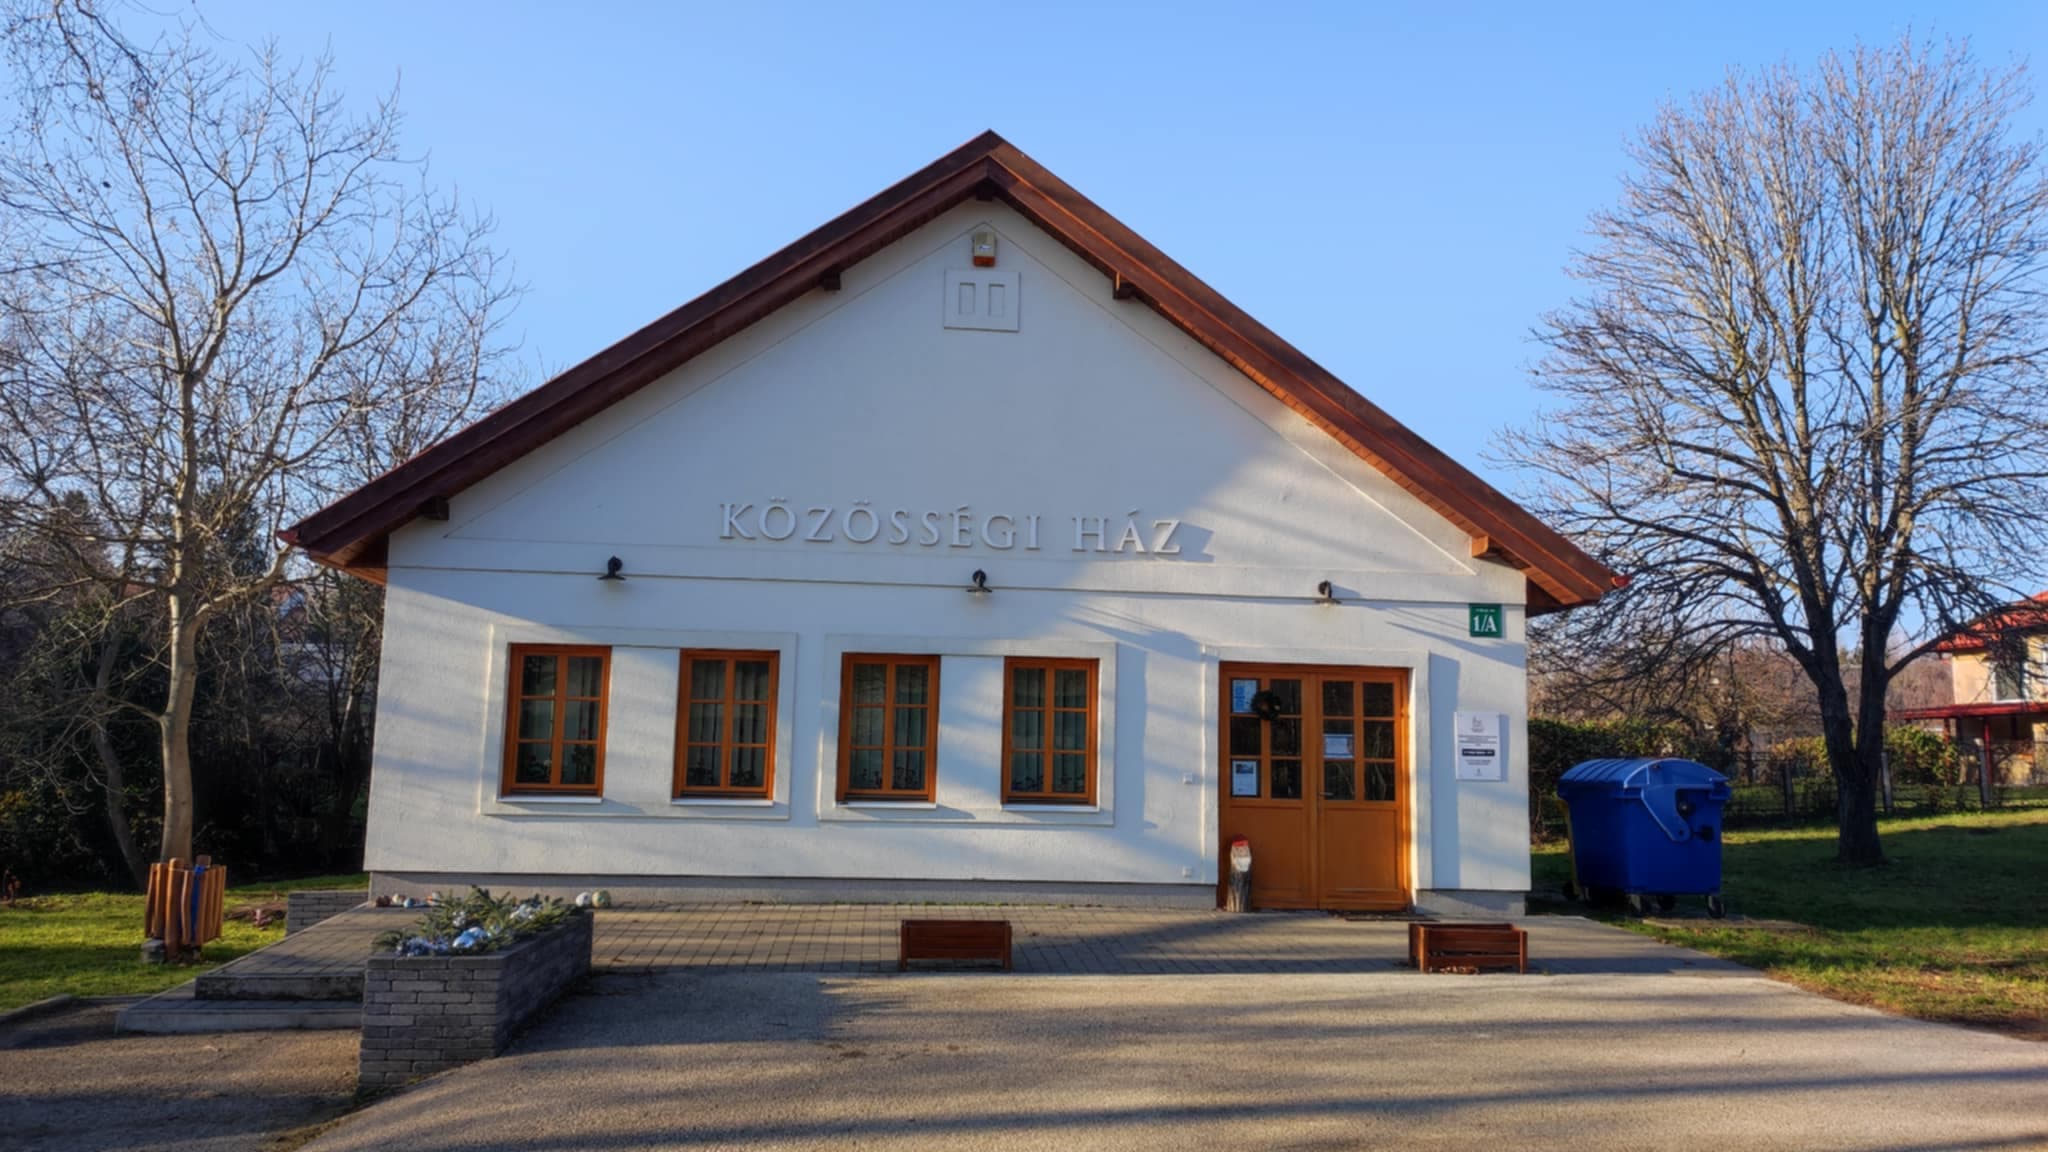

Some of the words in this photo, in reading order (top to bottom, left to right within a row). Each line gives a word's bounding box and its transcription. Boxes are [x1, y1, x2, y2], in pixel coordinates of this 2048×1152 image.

[720, 497, 1041, 551] KÖZÖSSÉGI
[1072, 509, 1182, 554] HÁZ
[1473, 615, 1498, 633] 1/A
